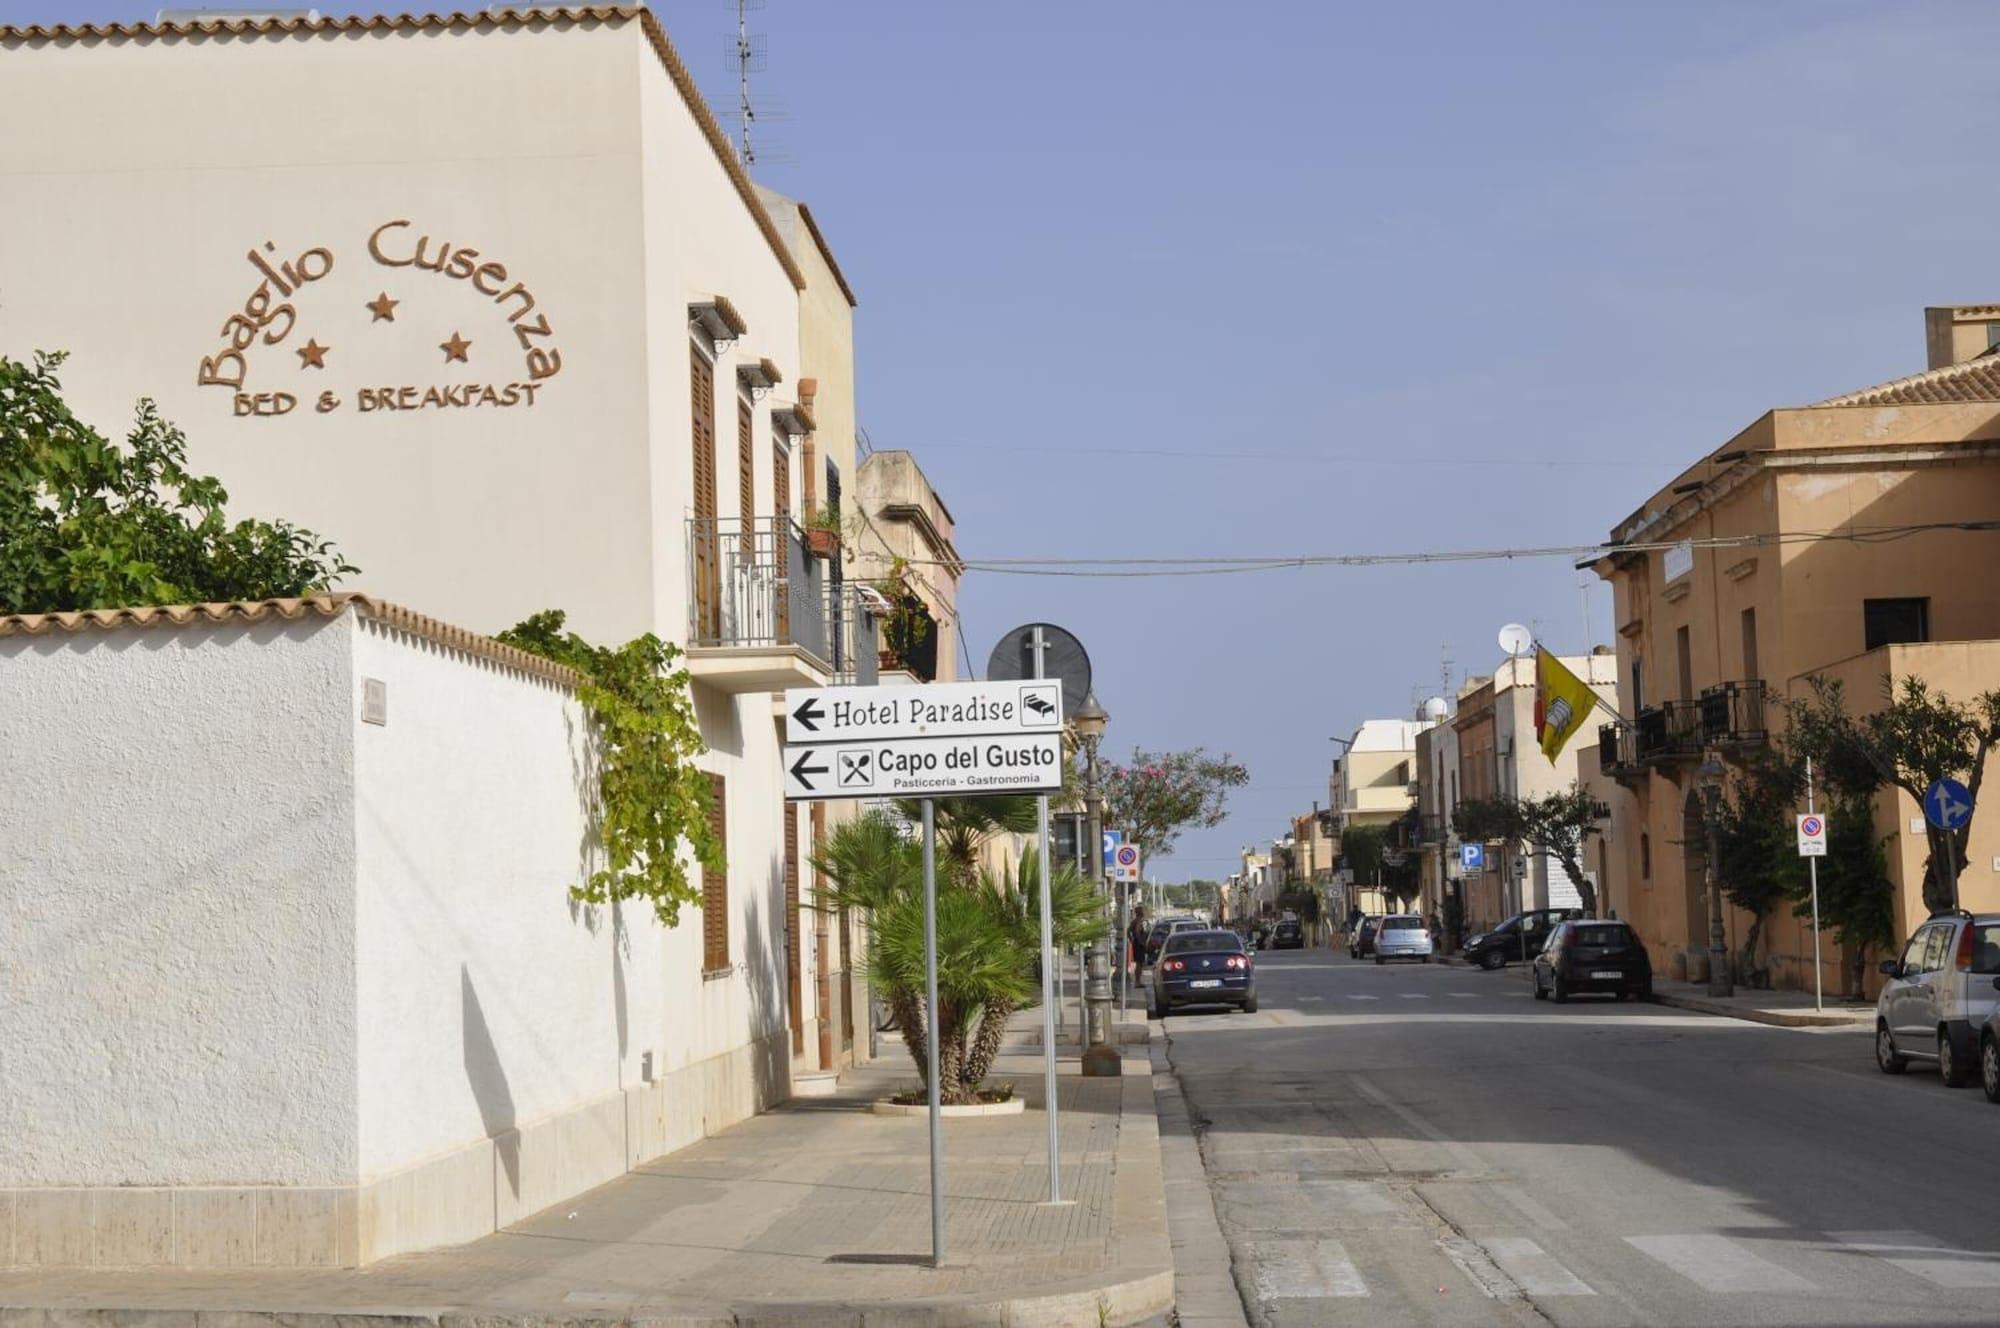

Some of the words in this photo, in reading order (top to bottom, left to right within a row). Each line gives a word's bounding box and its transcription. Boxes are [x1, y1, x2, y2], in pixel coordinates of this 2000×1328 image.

[198, 241, 333, 390] Baglio
[368, 220, 561, 381] Cusenza
[233, 392, 297, 416] BED
[315, 391, 341, 413] &
[358, 383, 542, 412] BREAKFAST
[833, 700, 899, 728] Hotel
[911, 695, 1013, 723] Paradise
[879, 748, 937, 776] Capo
[945, 745, 978, 769] del
[986, 744, 1054, 768] Gusto
[894, 777, 957, 788] Pasticceria
[967, 773, 1040, 785] Gastronomia
[1464, 846, 1479, 864] P
